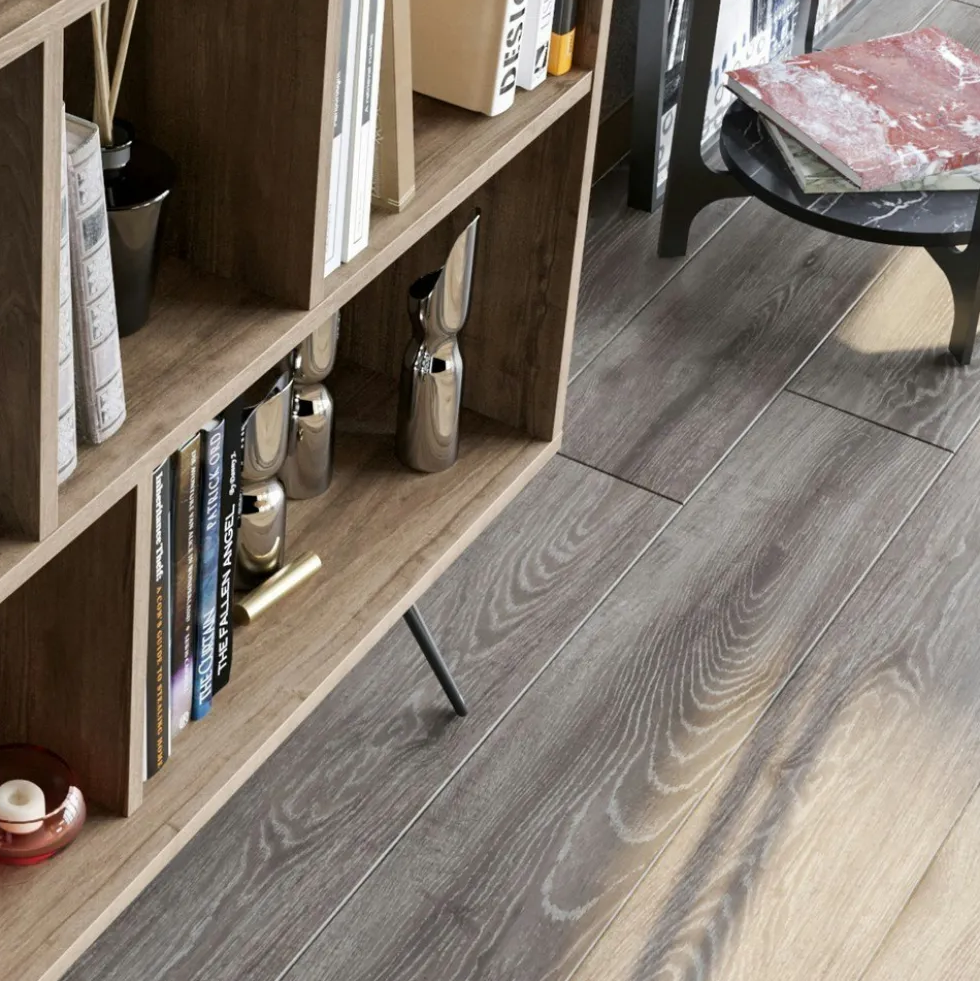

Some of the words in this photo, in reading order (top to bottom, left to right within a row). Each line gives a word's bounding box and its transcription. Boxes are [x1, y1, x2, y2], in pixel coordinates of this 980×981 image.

[206, 466, 220, 531] PATRICK
[223, 503, 236, 567] ANGEL
[219, 568, 232, 639] FALLEN
[198, 606, 216, 675] CURTAIN
[217, 636, 229, 676] THE
[198, 669, 213, 705] THE
